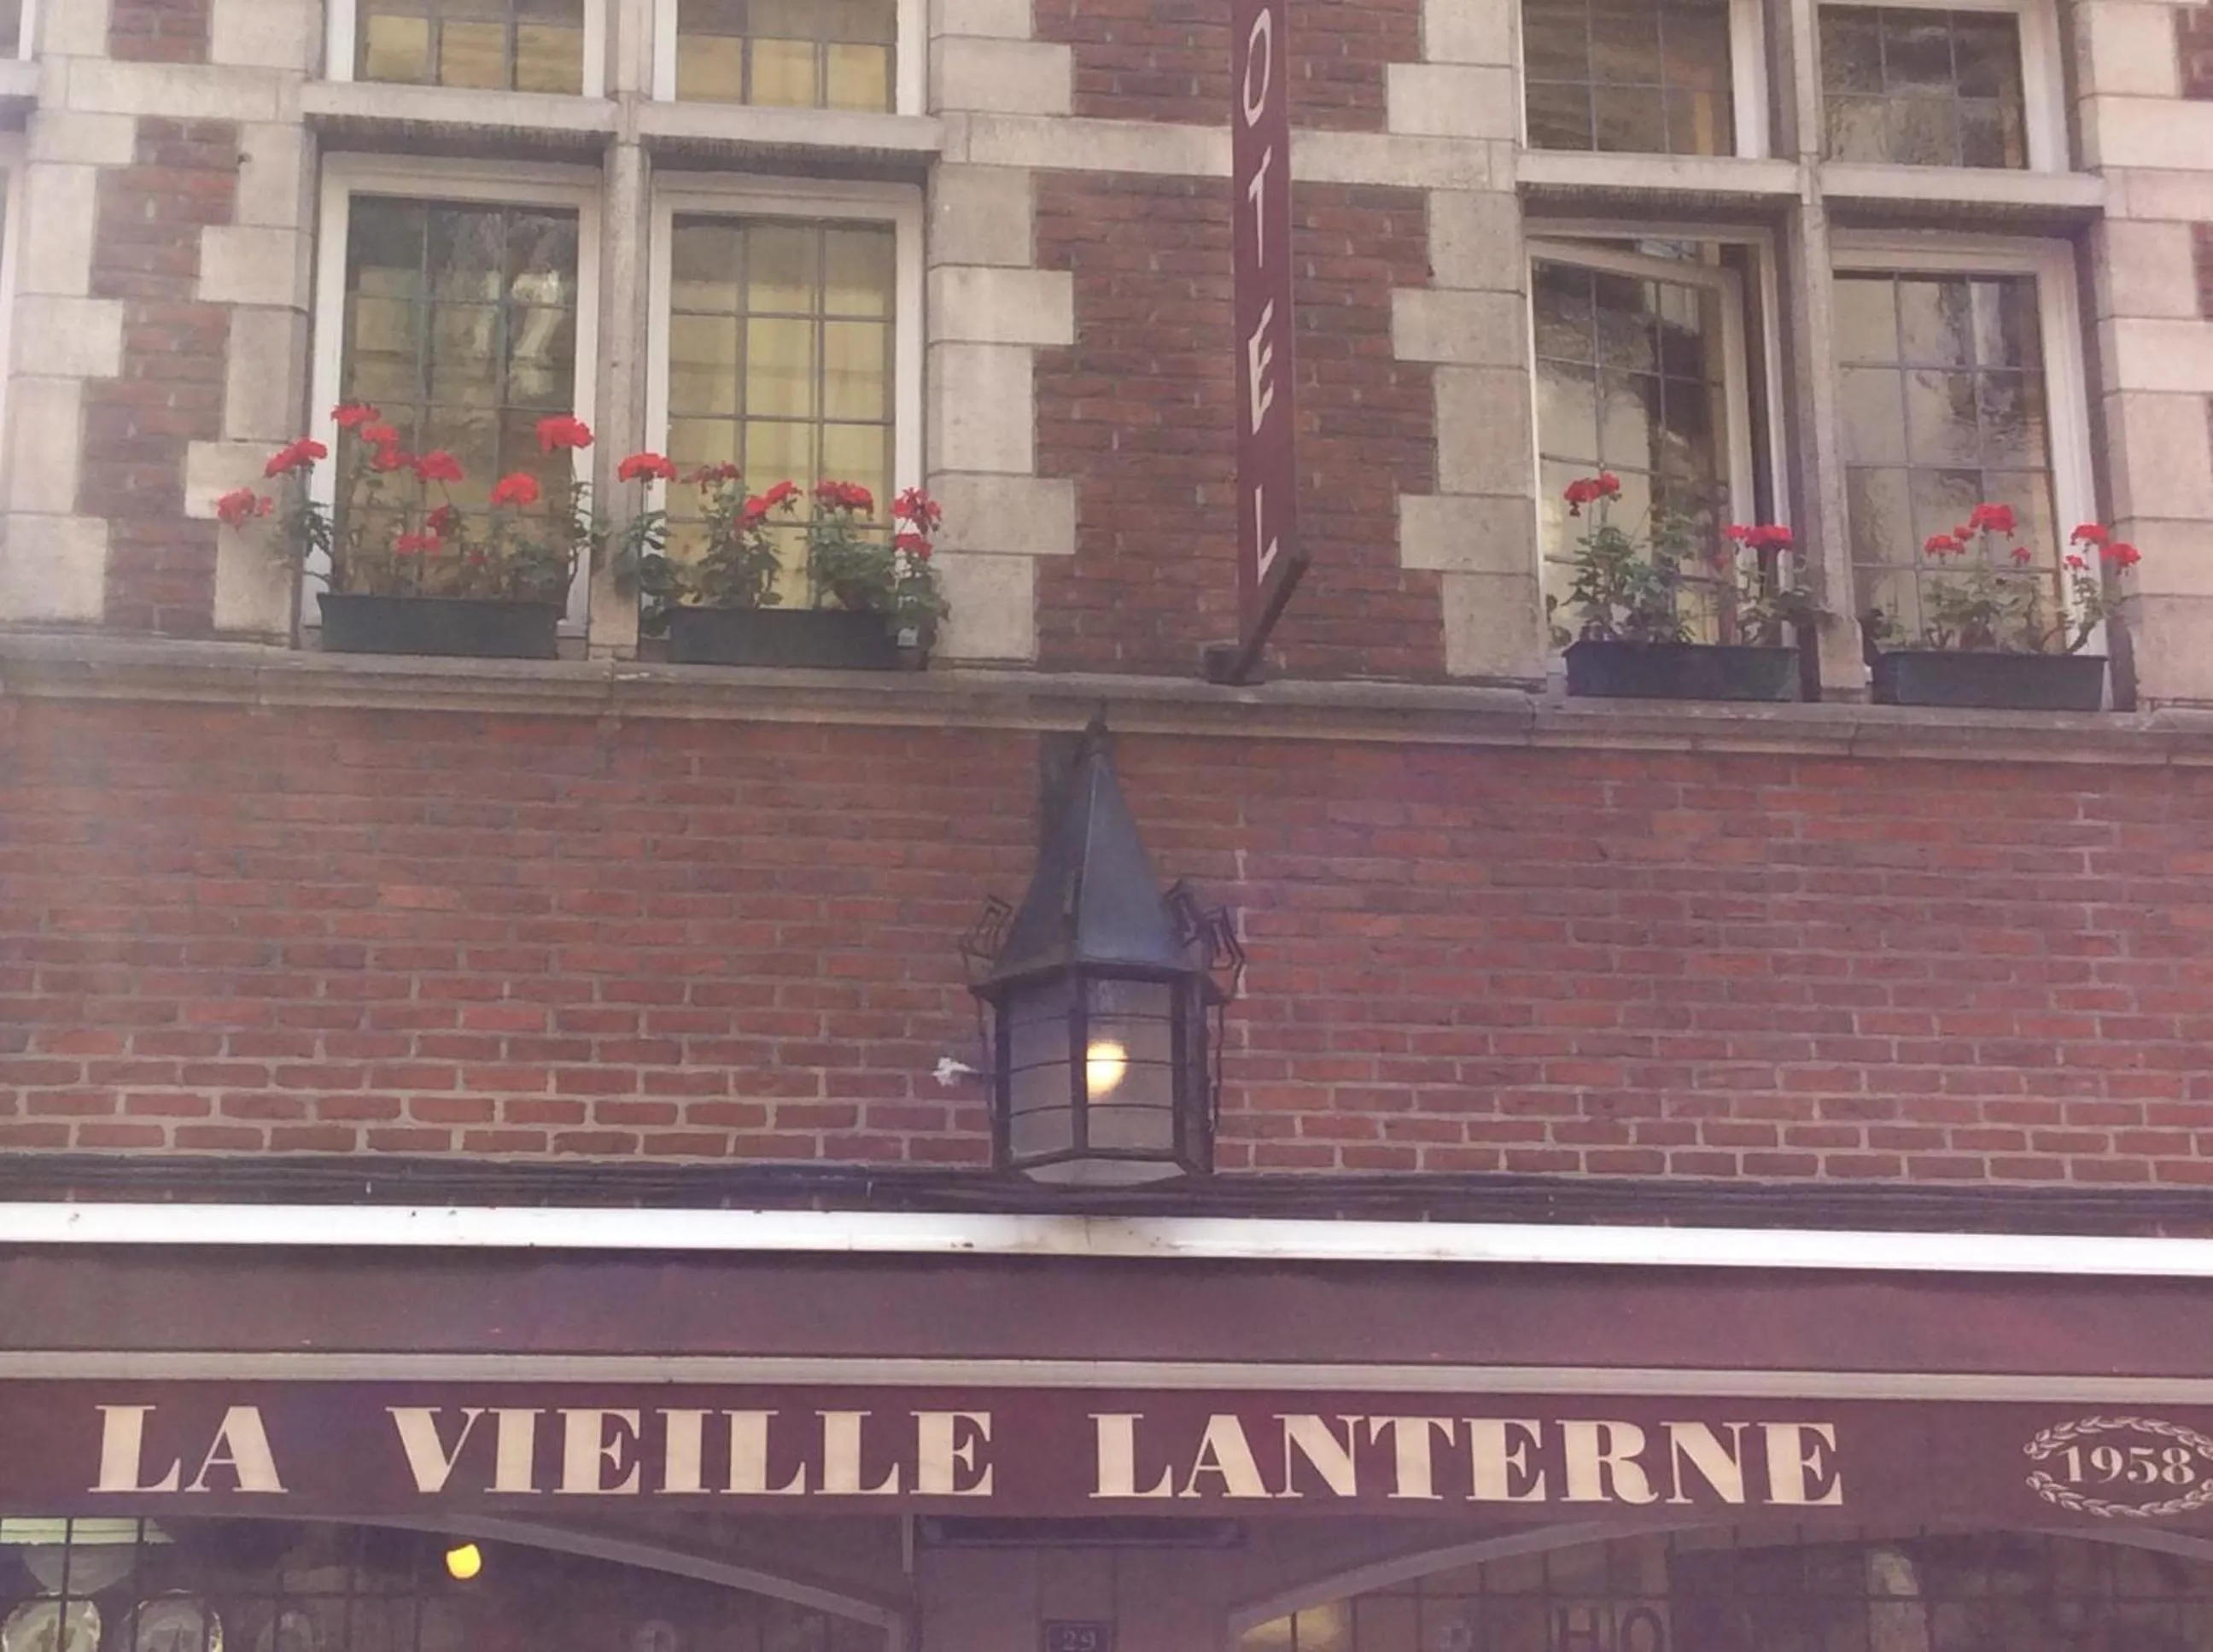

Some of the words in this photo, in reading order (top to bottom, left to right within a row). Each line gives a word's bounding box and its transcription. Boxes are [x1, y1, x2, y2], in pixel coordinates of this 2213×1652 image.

[88, 1404, 289, 1493] LA
[385, 1406, 993, 1496] VIEILLE
[1089, 1413, 1843, 1505] LANTERNE
[2058, 1445, 2196, 1485] 1958
